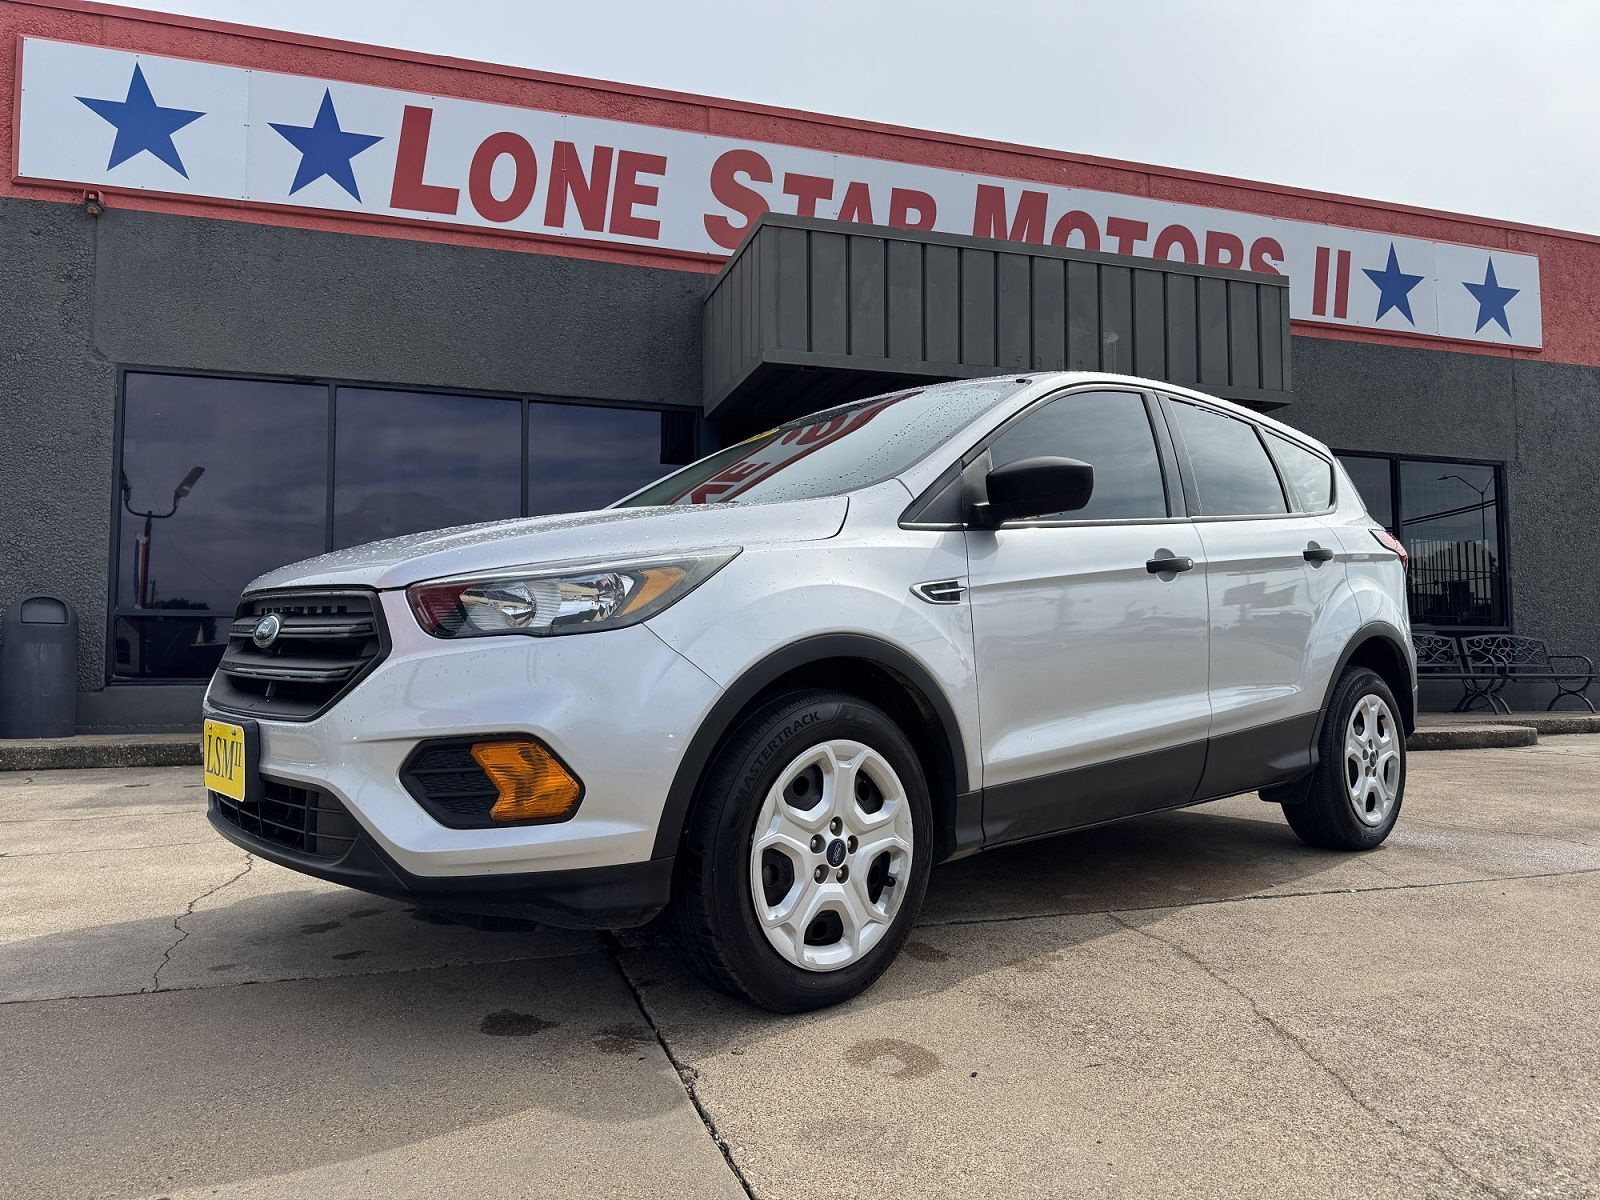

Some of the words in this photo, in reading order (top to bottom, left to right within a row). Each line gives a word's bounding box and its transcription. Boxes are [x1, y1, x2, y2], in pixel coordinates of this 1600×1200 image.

[389, 105, 667, 240] LONE
[704, 149, 937, 249] STAR
[1312, 246, 1351, 319] II
[735, 711, 820, 802] MASTERTRACK
